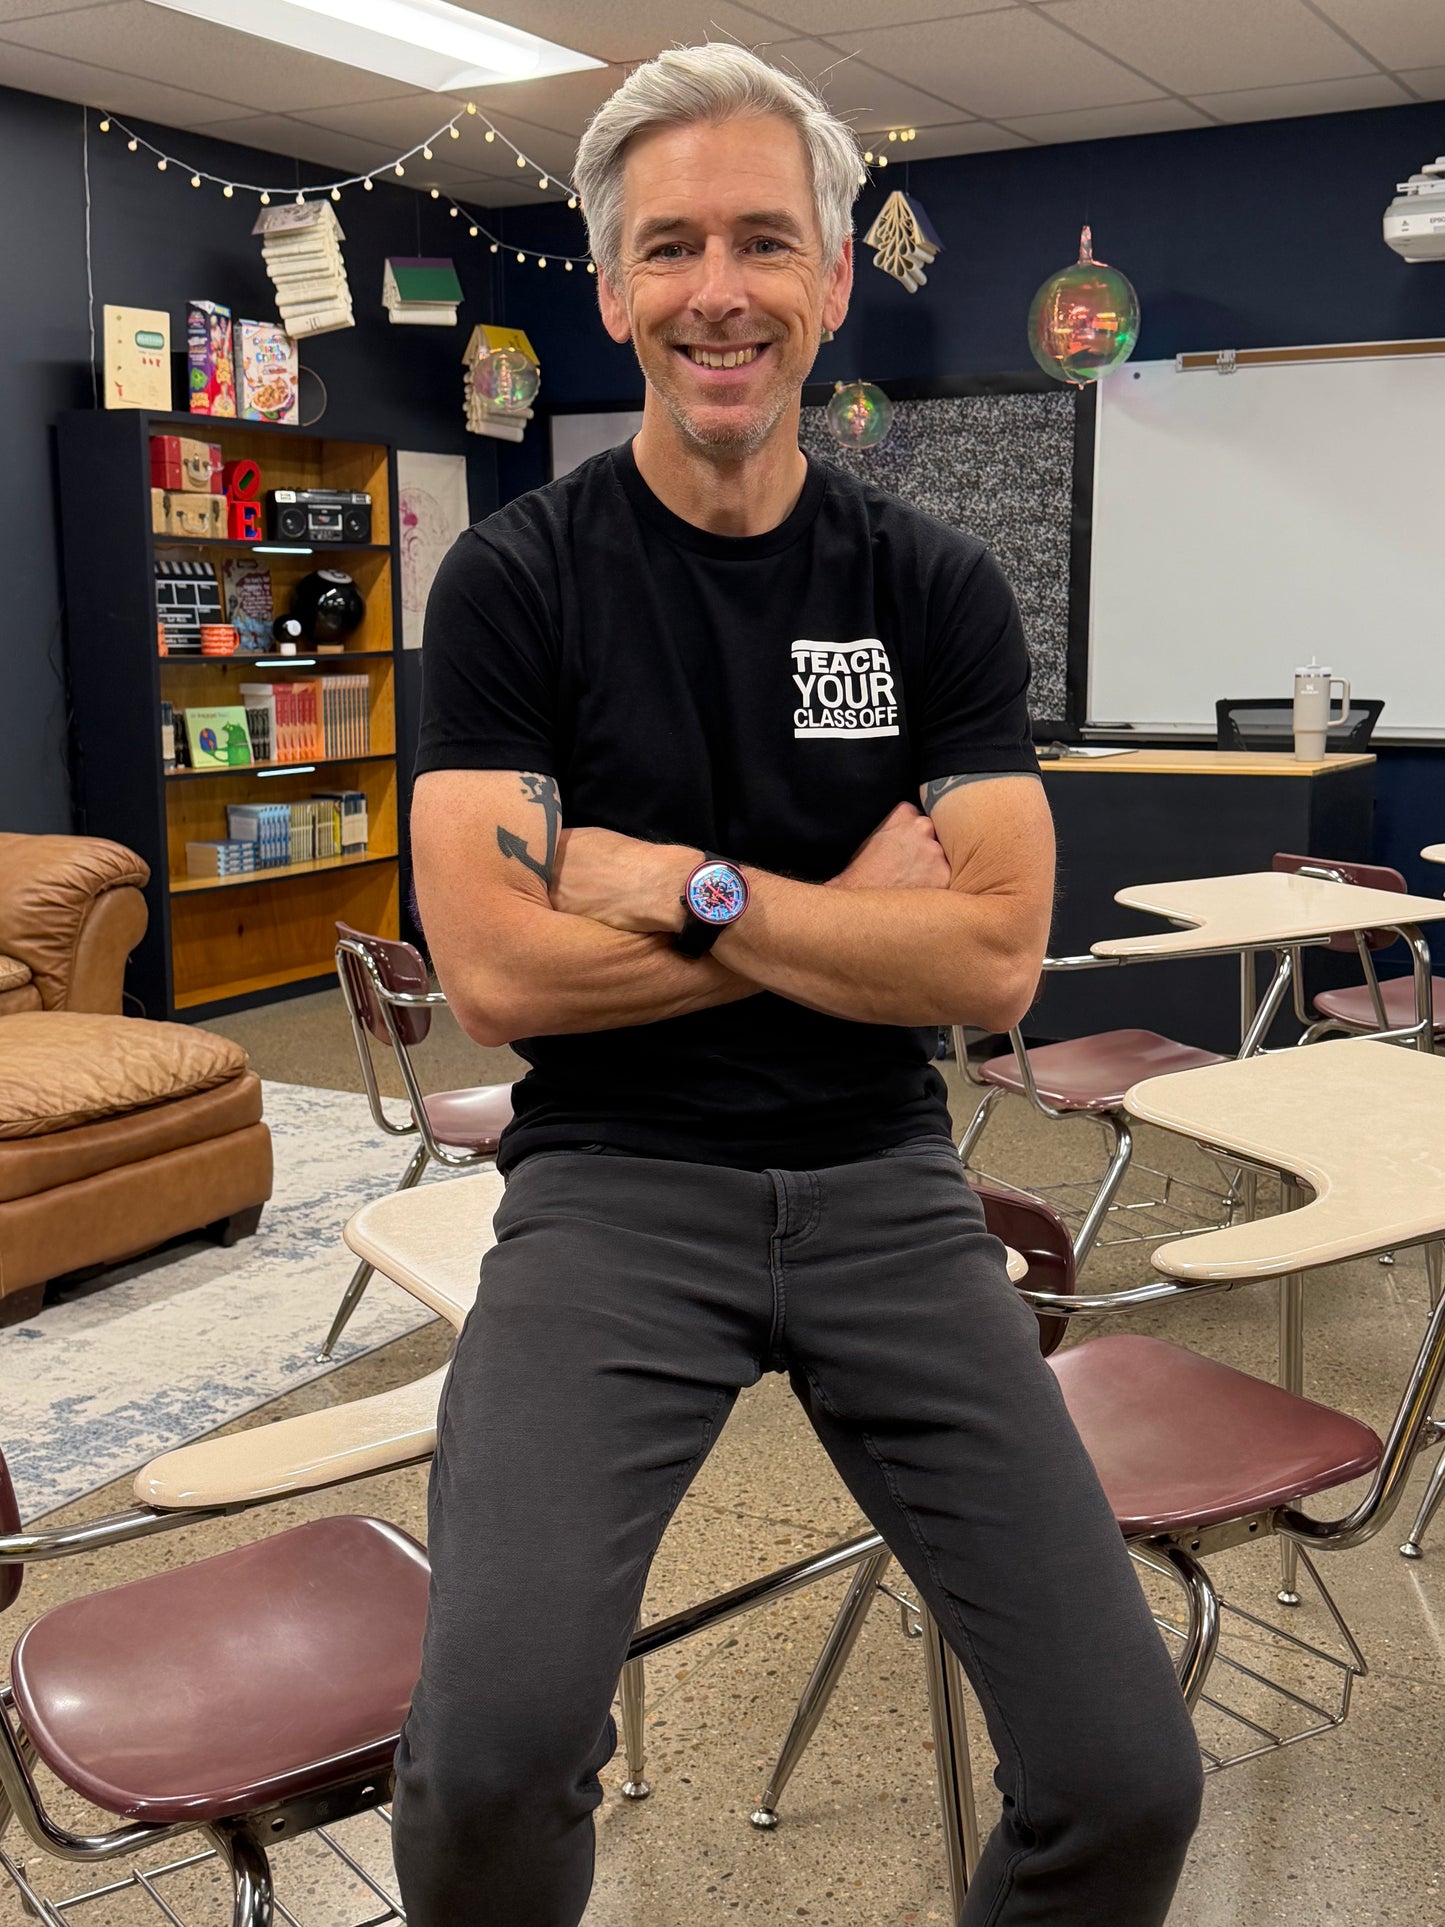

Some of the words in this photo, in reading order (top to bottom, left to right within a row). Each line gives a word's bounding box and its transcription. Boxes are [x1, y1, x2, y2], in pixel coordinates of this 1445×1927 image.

[256, 350, 286, 364] Crunch
[791, 649, 891, 675] TEACH
[792, 672, 897, 709] YOUR
[793, 708, 858, 728] CLASS
[859, 706, 898, 727] OFF
